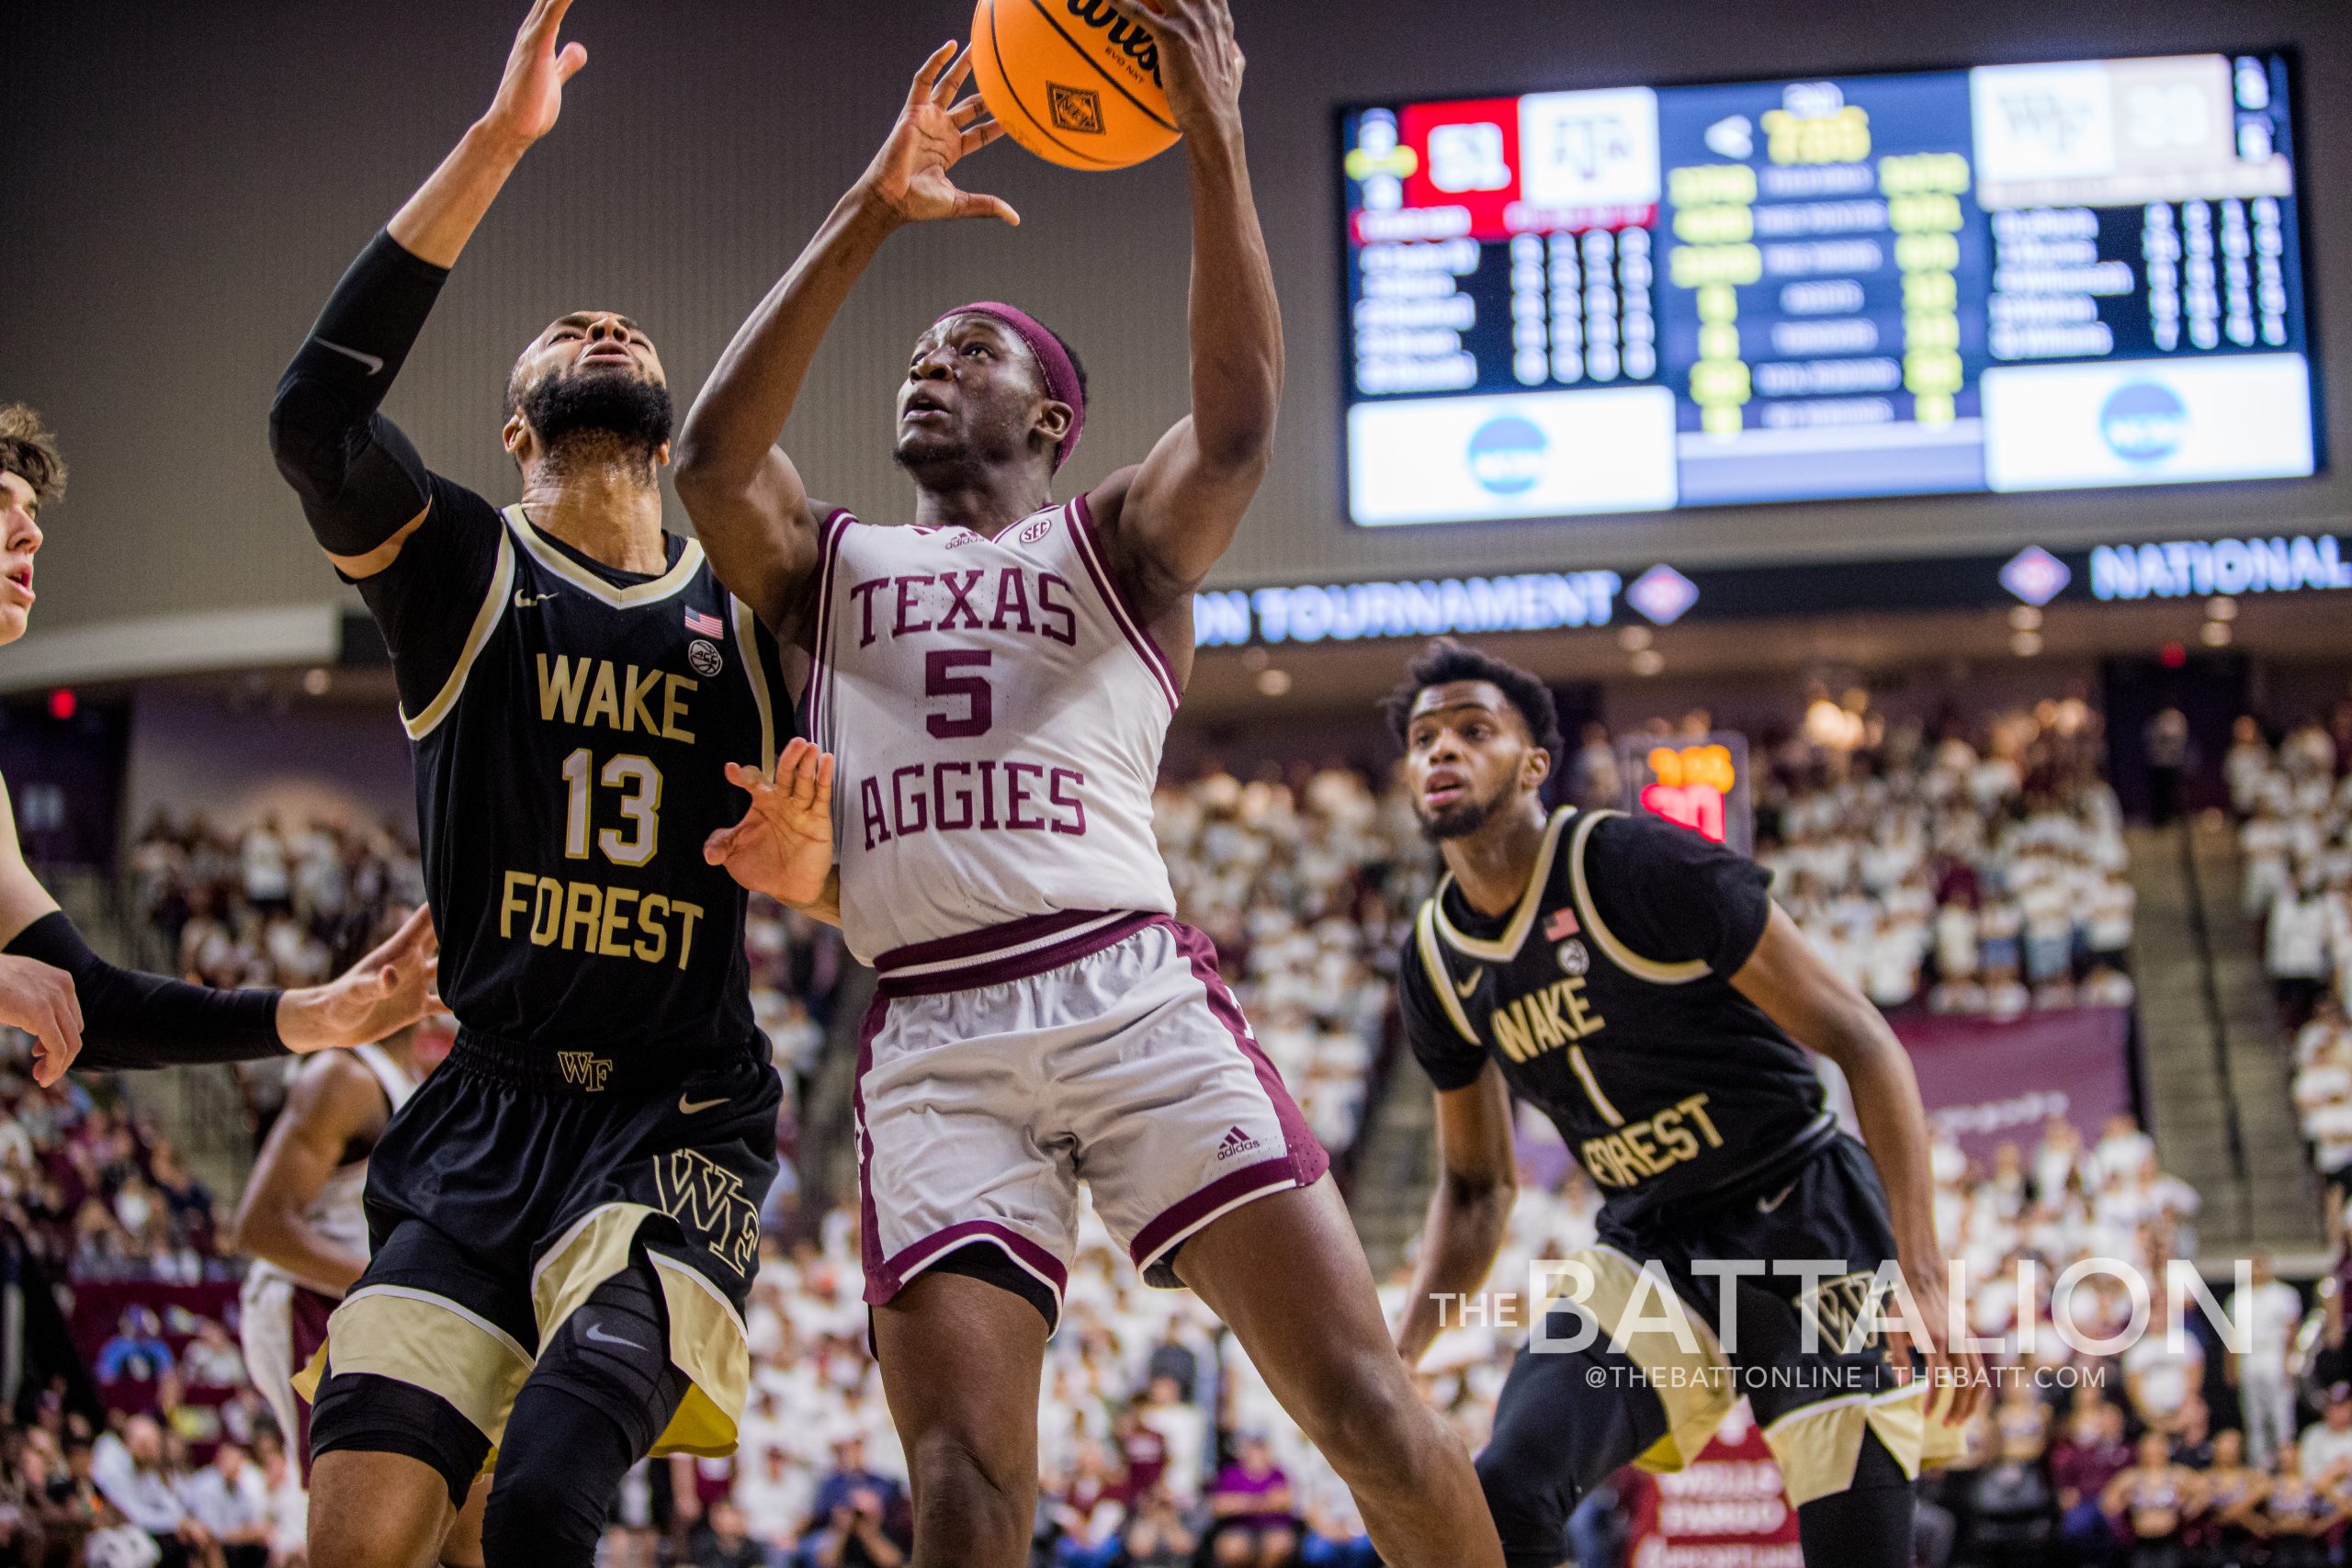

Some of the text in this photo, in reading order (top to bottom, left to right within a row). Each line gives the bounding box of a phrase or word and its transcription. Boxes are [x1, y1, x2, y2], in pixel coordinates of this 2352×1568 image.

[1023, 521, 1048, 540] SEC
[2089, 534, 2352, 601] NATIONAL
[850, 567, 1077, 649] TEXAS
[1250, 570, 1623, 644] TOURNAMENT
[536, 653, 698, 745] WAKE
[925, 649, 992, 739] 5
[561, 748, 663, 868] 13
[861, 761, 1087, 852] AGGIES
[500, 870, 705, 971] FOREST
[1490, 976, 1606, 1063] WAKE
[557, 1051, 613, 1092] WF
[1567, 1043, 1626, 1128] 1
[1217, 1139, 1261, 1161] adidas
[652, 1147, 761, 1279] WF
